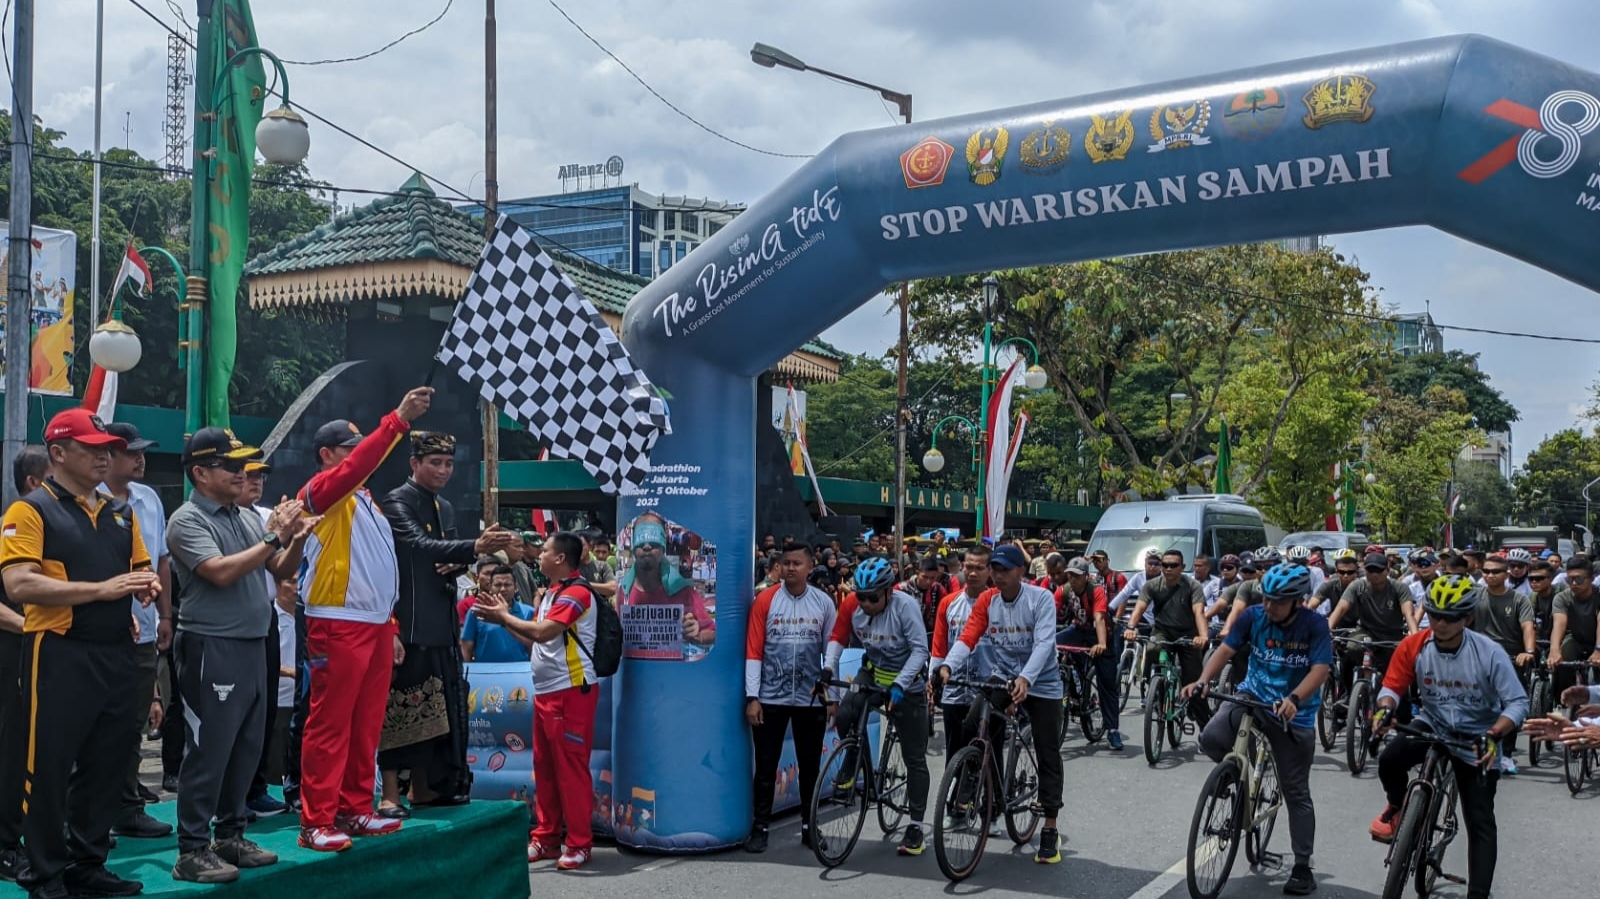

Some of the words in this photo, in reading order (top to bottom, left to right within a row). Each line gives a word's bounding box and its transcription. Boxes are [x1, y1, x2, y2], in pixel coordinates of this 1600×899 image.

[558, 163, 603, 180] Allianz
[880, 205, 968, 240] STOP
[973, 175, 1187, 229] WARISKAN
[1197, 148, 1392, 201] SAMPAH
[682, 327, 689, 336] A
[689, 303, 725, 331] Grassroot
[725, 275, 764, 305] Movement
[763, 266, 775, 279] for
[775, 229, 825, 270] Sustainability
[653, 292, 697, 337] The
[650, 474, 689, 484] Jakarta
[656, 486, 664, 495] 5
[665, 486, 708, 496] Oktober
[881, 486, 951, 509] HLANG
[635, 497, 660, 507] 2023
